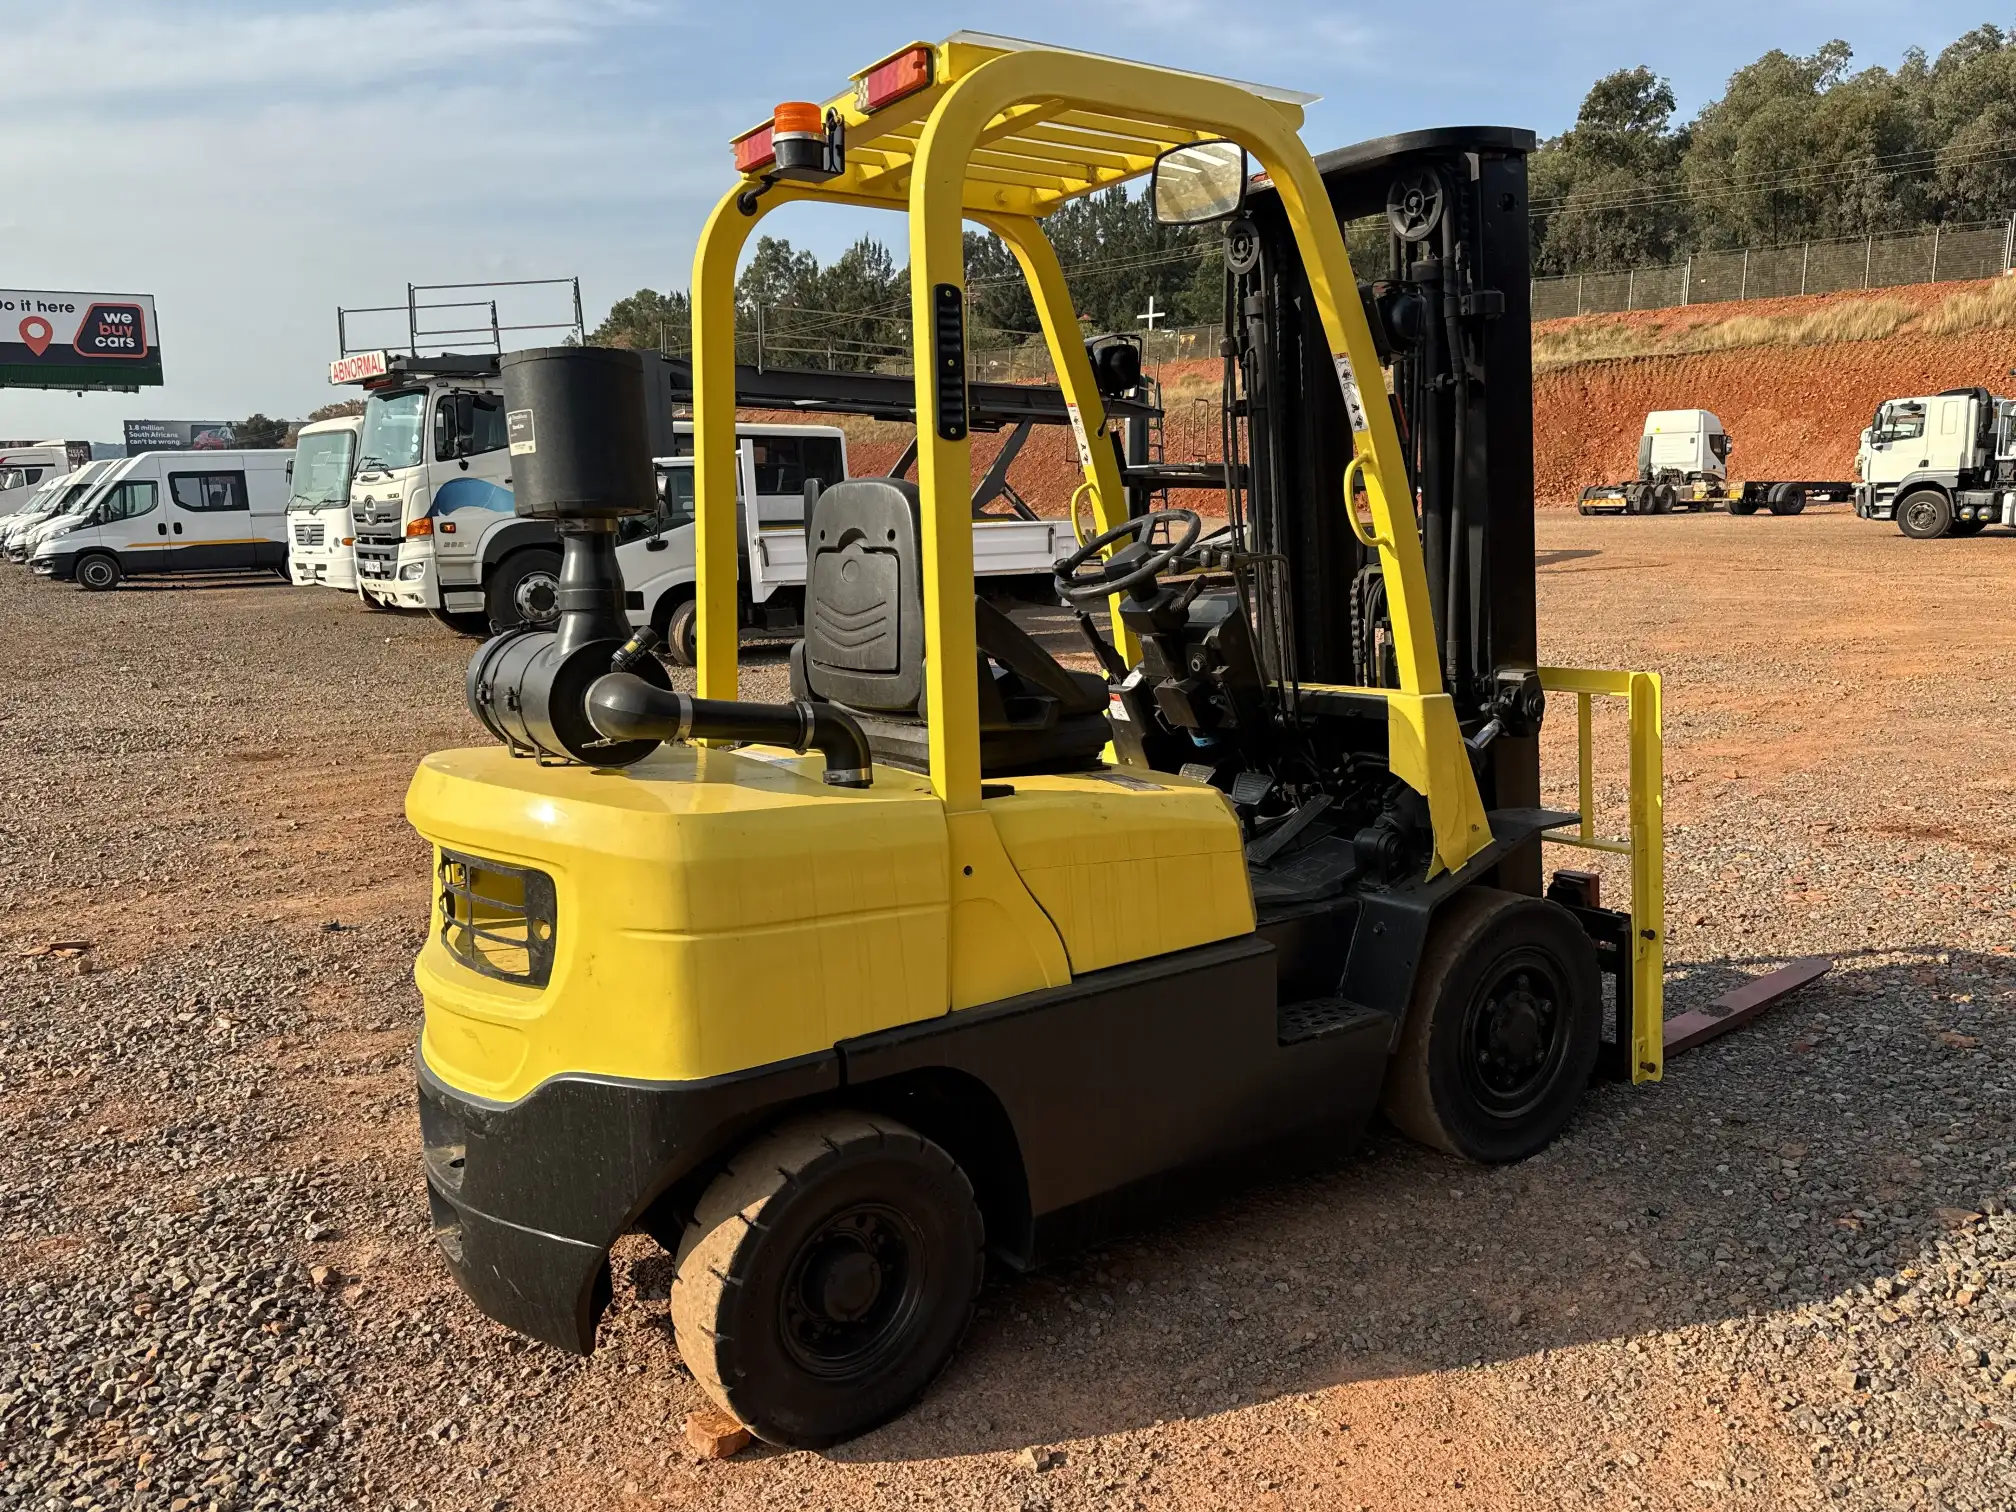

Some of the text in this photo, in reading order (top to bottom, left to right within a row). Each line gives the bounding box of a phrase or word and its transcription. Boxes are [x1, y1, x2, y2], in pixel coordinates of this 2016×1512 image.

[21, 299, 31, 311] it
[37, 301, 75, 313] here
[103, 313, 133, 323] we
[99, 322, 133, 337] buy
[95, 337, 135, 347] cars
[333, 353, 384, 382] ABNORMAL
